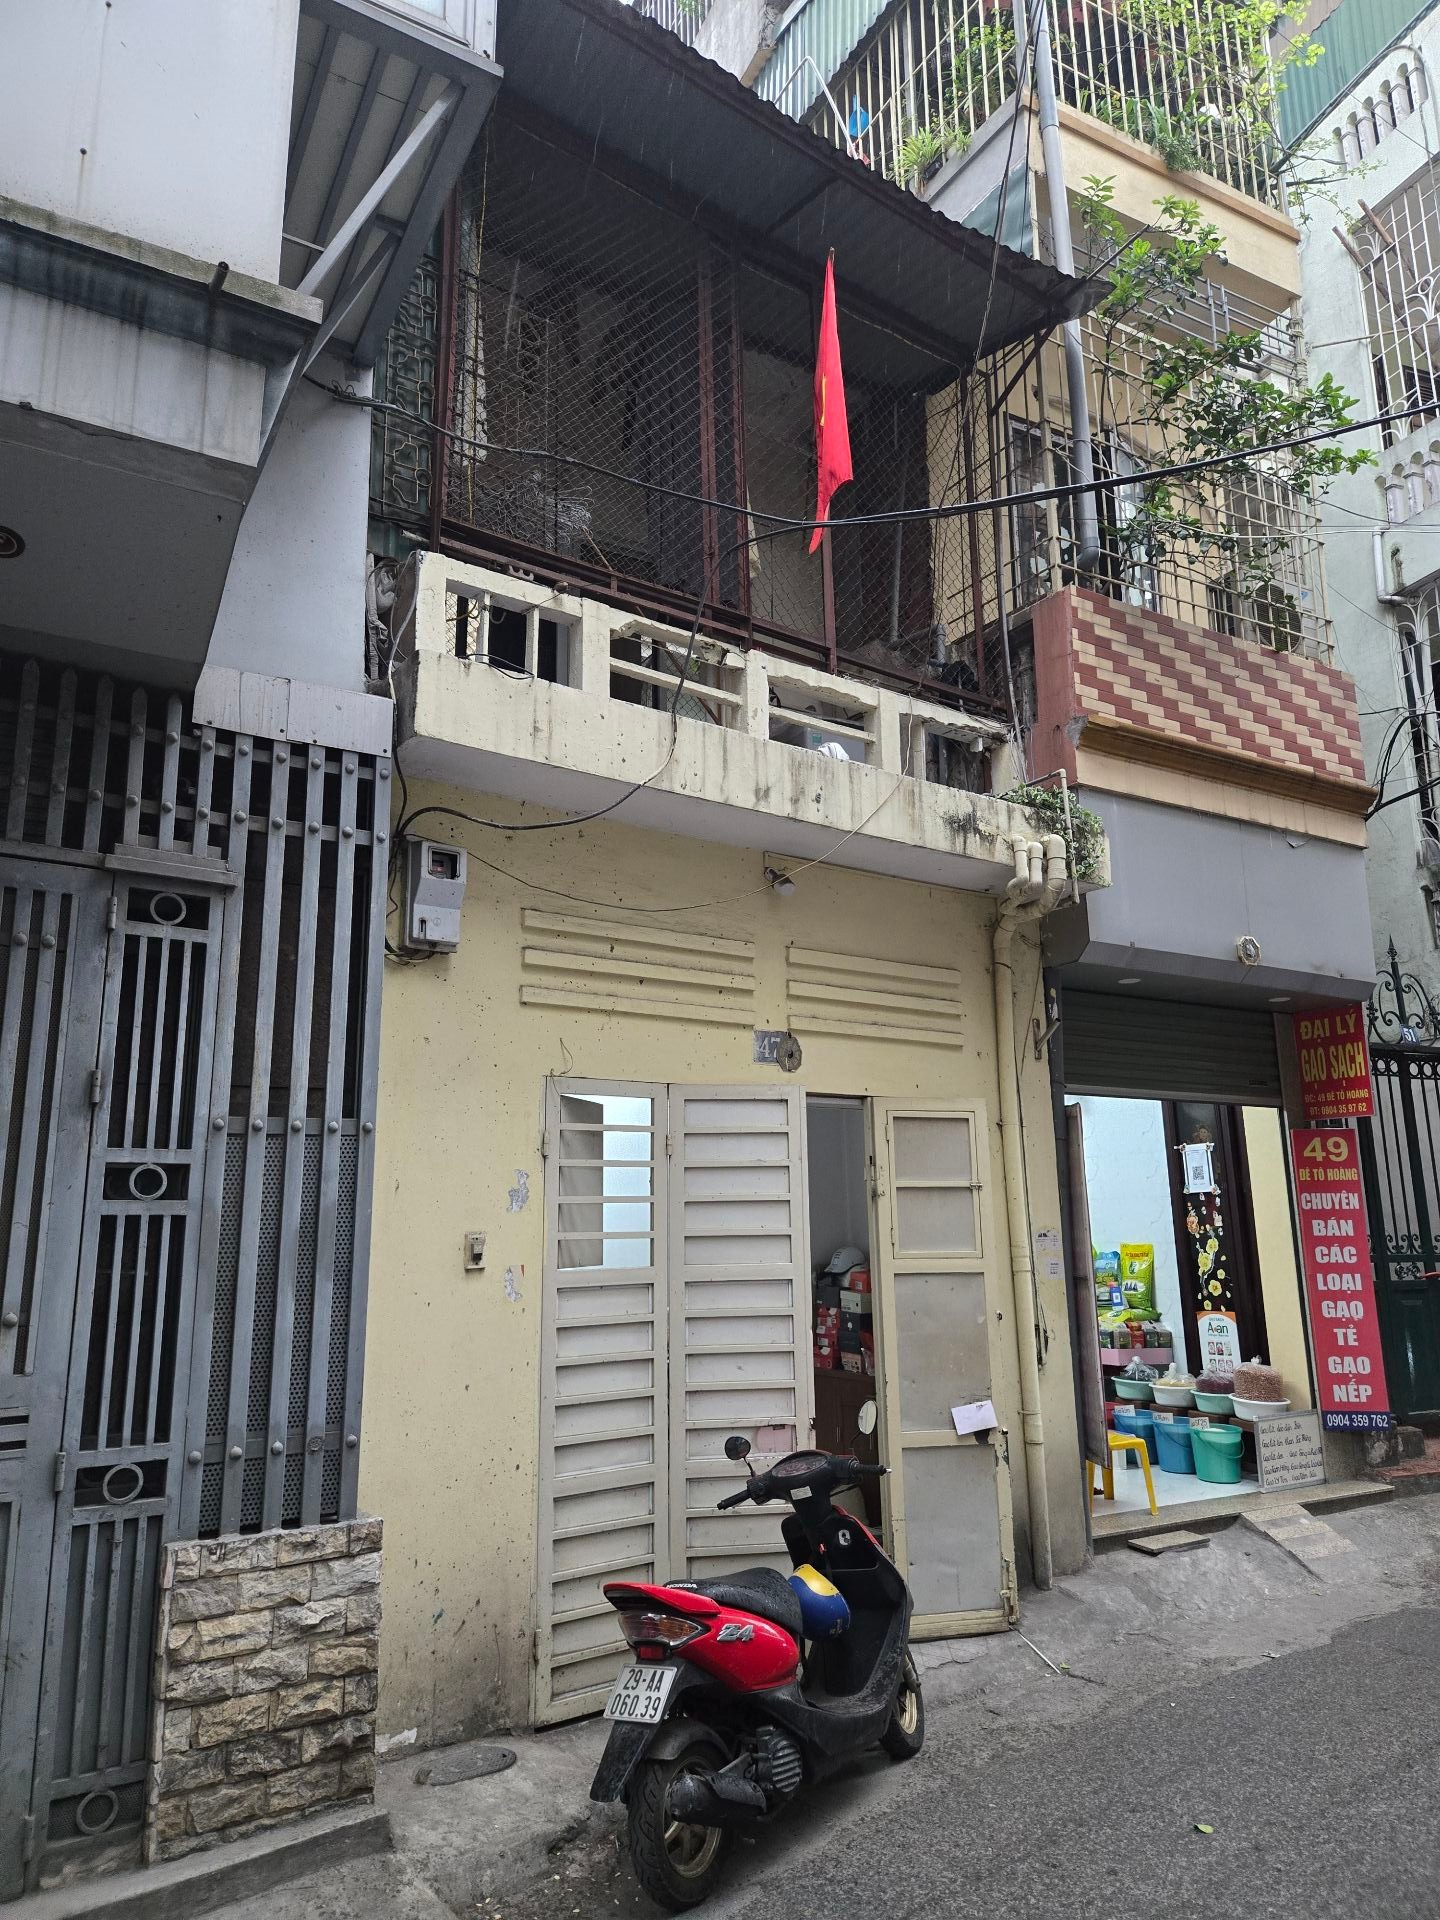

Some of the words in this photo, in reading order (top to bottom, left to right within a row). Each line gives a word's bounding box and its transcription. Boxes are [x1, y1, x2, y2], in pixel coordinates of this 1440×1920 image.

[1300, 1018, 1330, 1042] ĐẠI
[1336, 1009, 1356, 1035] LÝ
[1403, 1028, 1416, 1042] 51
[1301, 1047, 1327, 1090] GẠO
[1330, 1042, 1366, 1087] SẠCH
[1321, 1105, 1337, 1115] 0904
[1338, 1104, 1347, 1114] 35
[1348, 1103, 1357, 1112] 97
[1358, 1102, 1367, 1112] 62
[1303, 1137, 1349, 1162] 49
[1313, 1166, 1324, 1181] TÔ
[1327, 1166, 1358, 1181] HOÀNG
[1301, 1190, 1360, 1210] CHUYÊN
[1312, 1217, 1354, 1236] BÁN
[1315, 1243, 1357, 1264] CÁC
[1317, 1273, 1362, 1294] LOẠI
[1333, 1324, 1358, 1346] TẺ
[1327, 1356, 1371, 1377] GẠO
[1333, 1378, 1372, 1402] NẾP
[1327, 1414, 1350, 1427] 0904
[1352, 1414, 1369, 1427] 359
[1371, 1415, 1388, 1428] 762
[717, 1623, 755, 1642] Z4
[623, 1668, 665, 1693] 29-AA
[610, 1693, 662, 1719] 060.39
